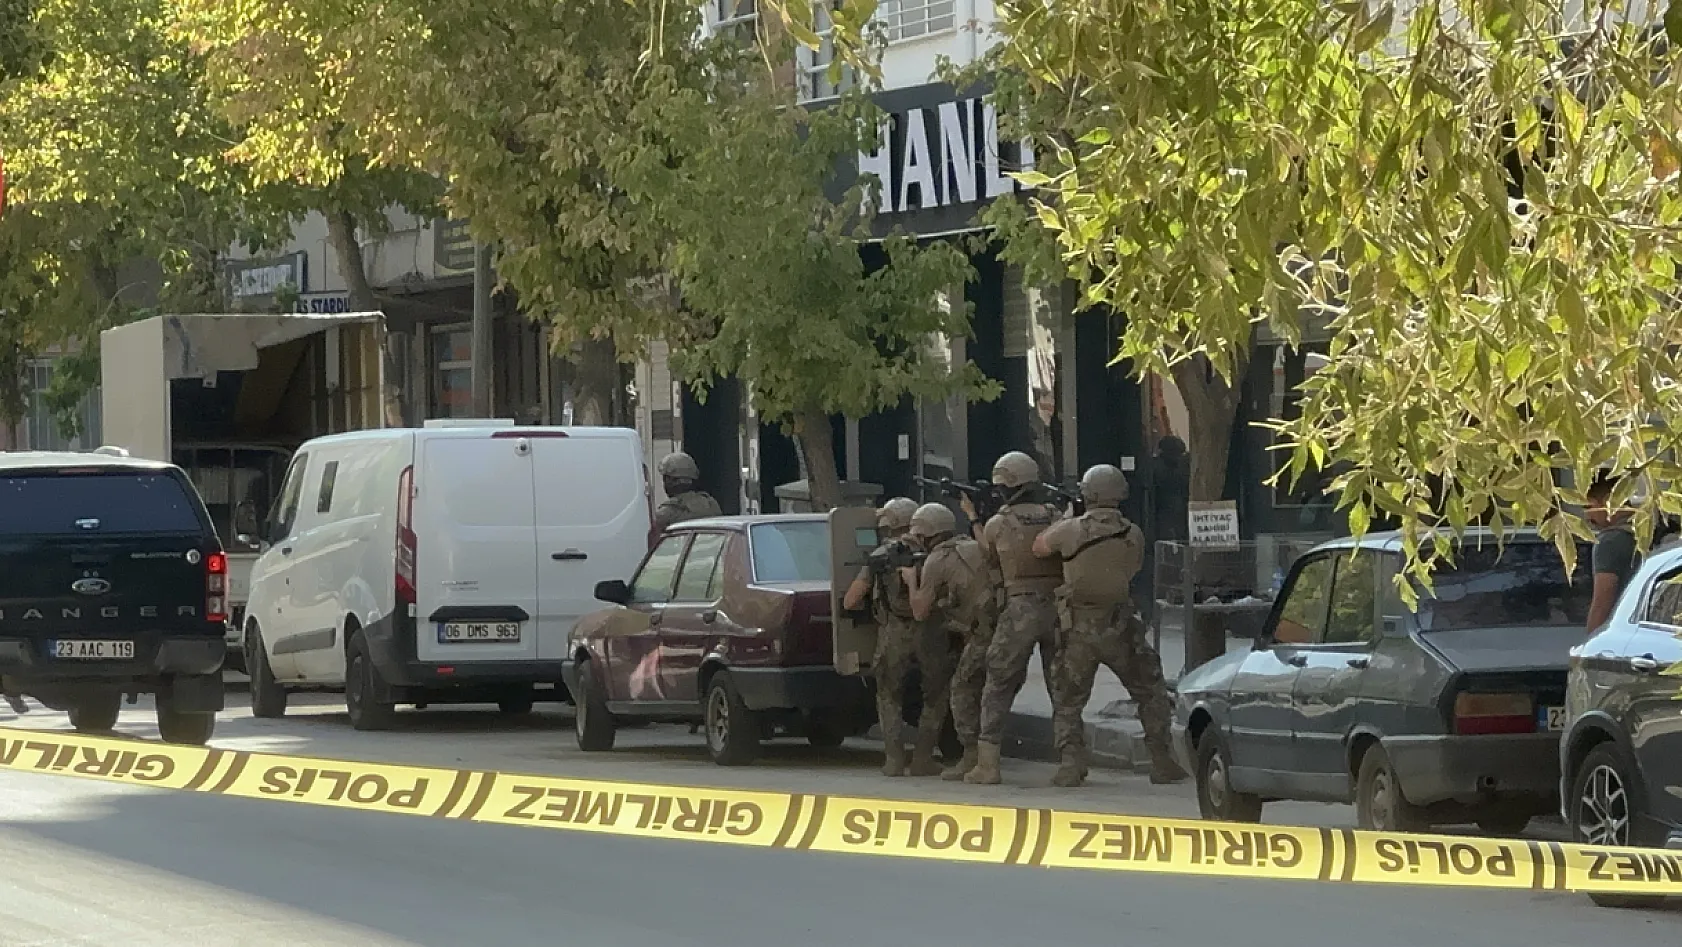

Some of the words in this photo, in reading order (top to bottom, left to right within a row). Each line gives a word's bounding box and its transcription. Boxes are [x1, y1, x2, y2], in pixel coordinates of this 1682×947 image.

[0, 605, 196, 620] ANGER
[446, 624, 460, 637] 06
[467, 624, 488, 637] DMS
[496, 624, 517, 637] 963
[57, 641, 72, 656] 23
[80, 641, 103, 656] AAC
[112, 641, 132, 656] 119
[258, 765, 429, 809] POLİS
[503, 785, 763, 836] GİRİLMEZ
[842, 808, 993, 853] POLİS
[1068, 822, 1303, 867] GİRİLMEZ
[1375, 838, 1517, 878] POLİS
[1580, 850, 1682, 882] MEZ
